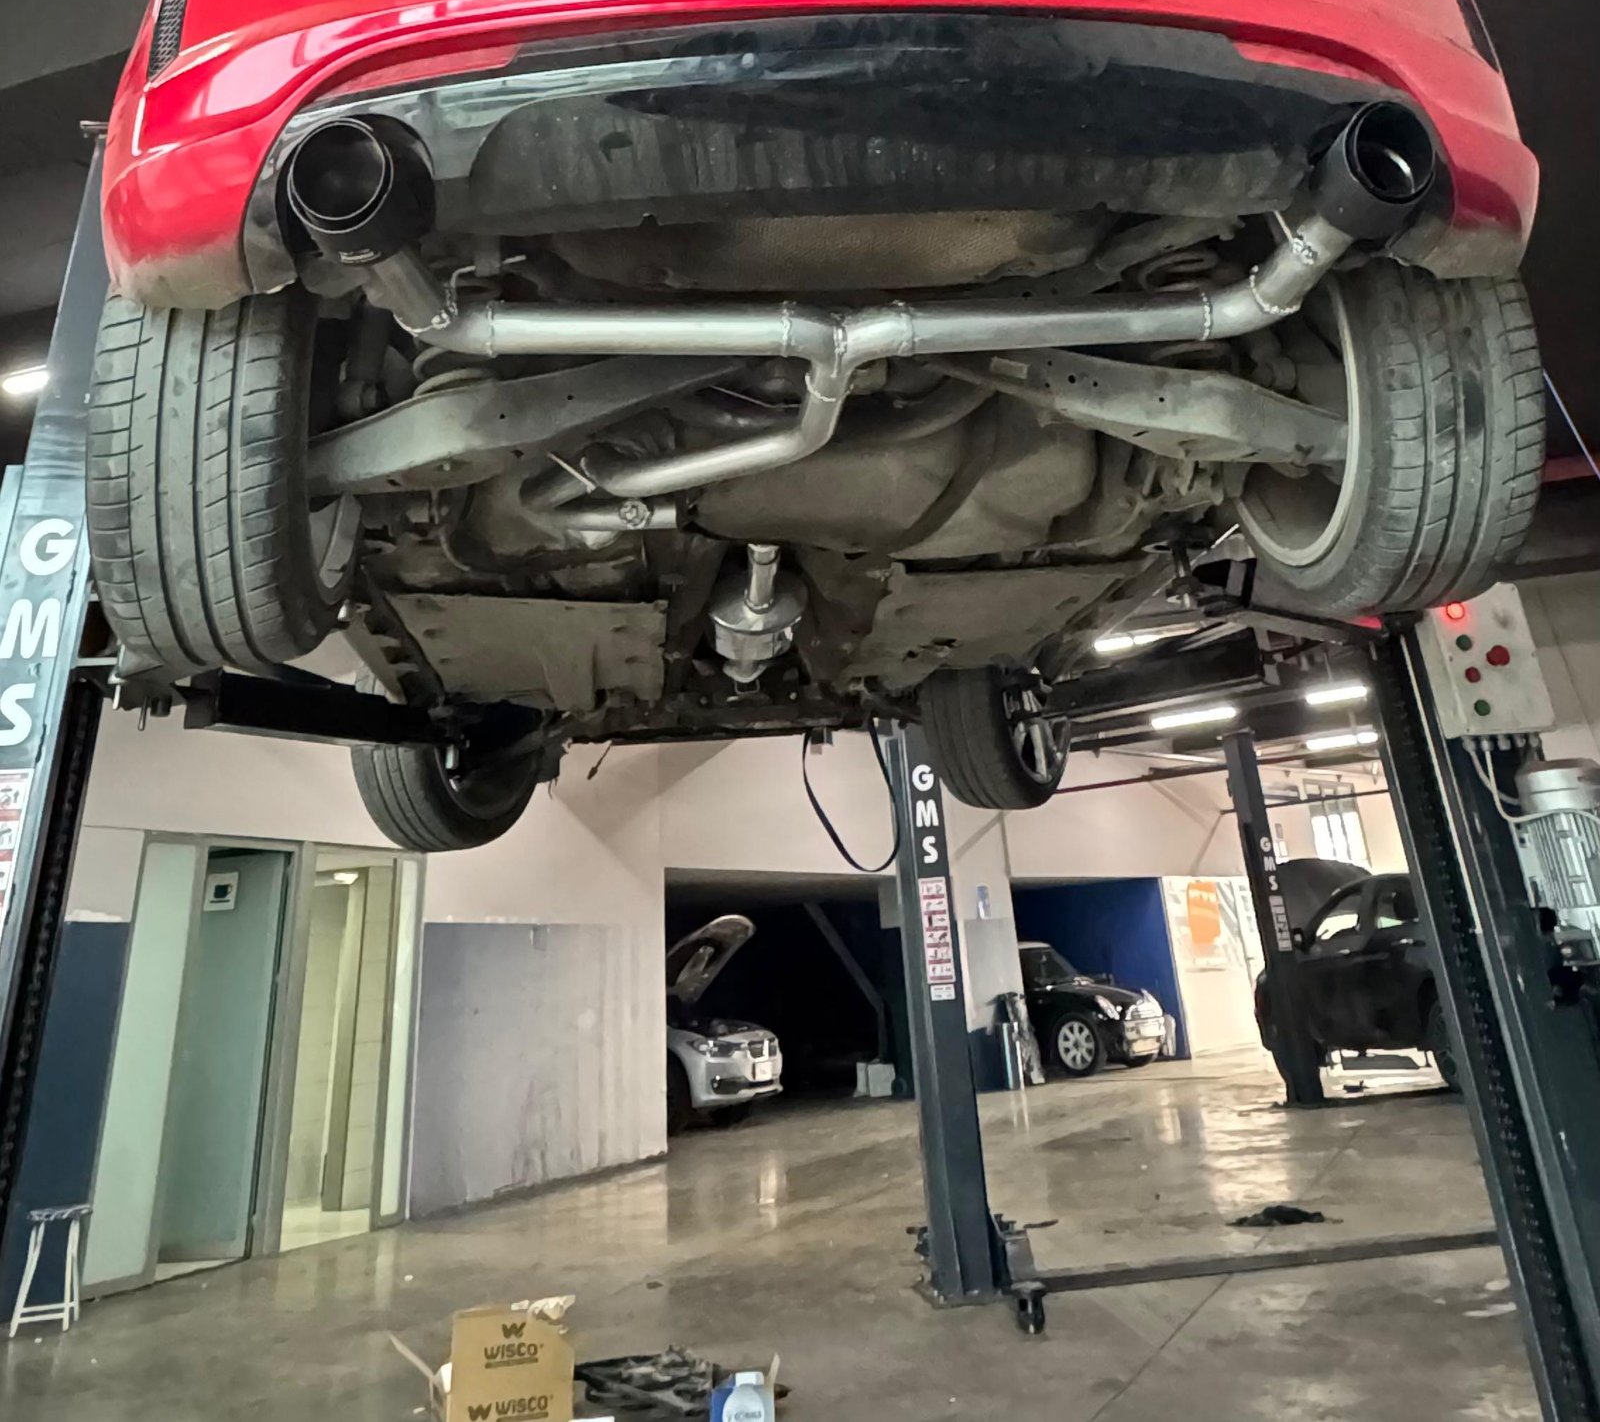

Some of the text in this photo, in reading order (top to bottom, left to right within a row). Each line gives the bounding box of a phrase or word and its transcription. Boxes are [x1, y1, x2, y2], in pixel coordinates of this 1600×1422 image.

[912, 764, 940, 863] GMS
[484, 1342, 539, 1361] WISCO
[496, 1395, 549, 1416] WISCO
